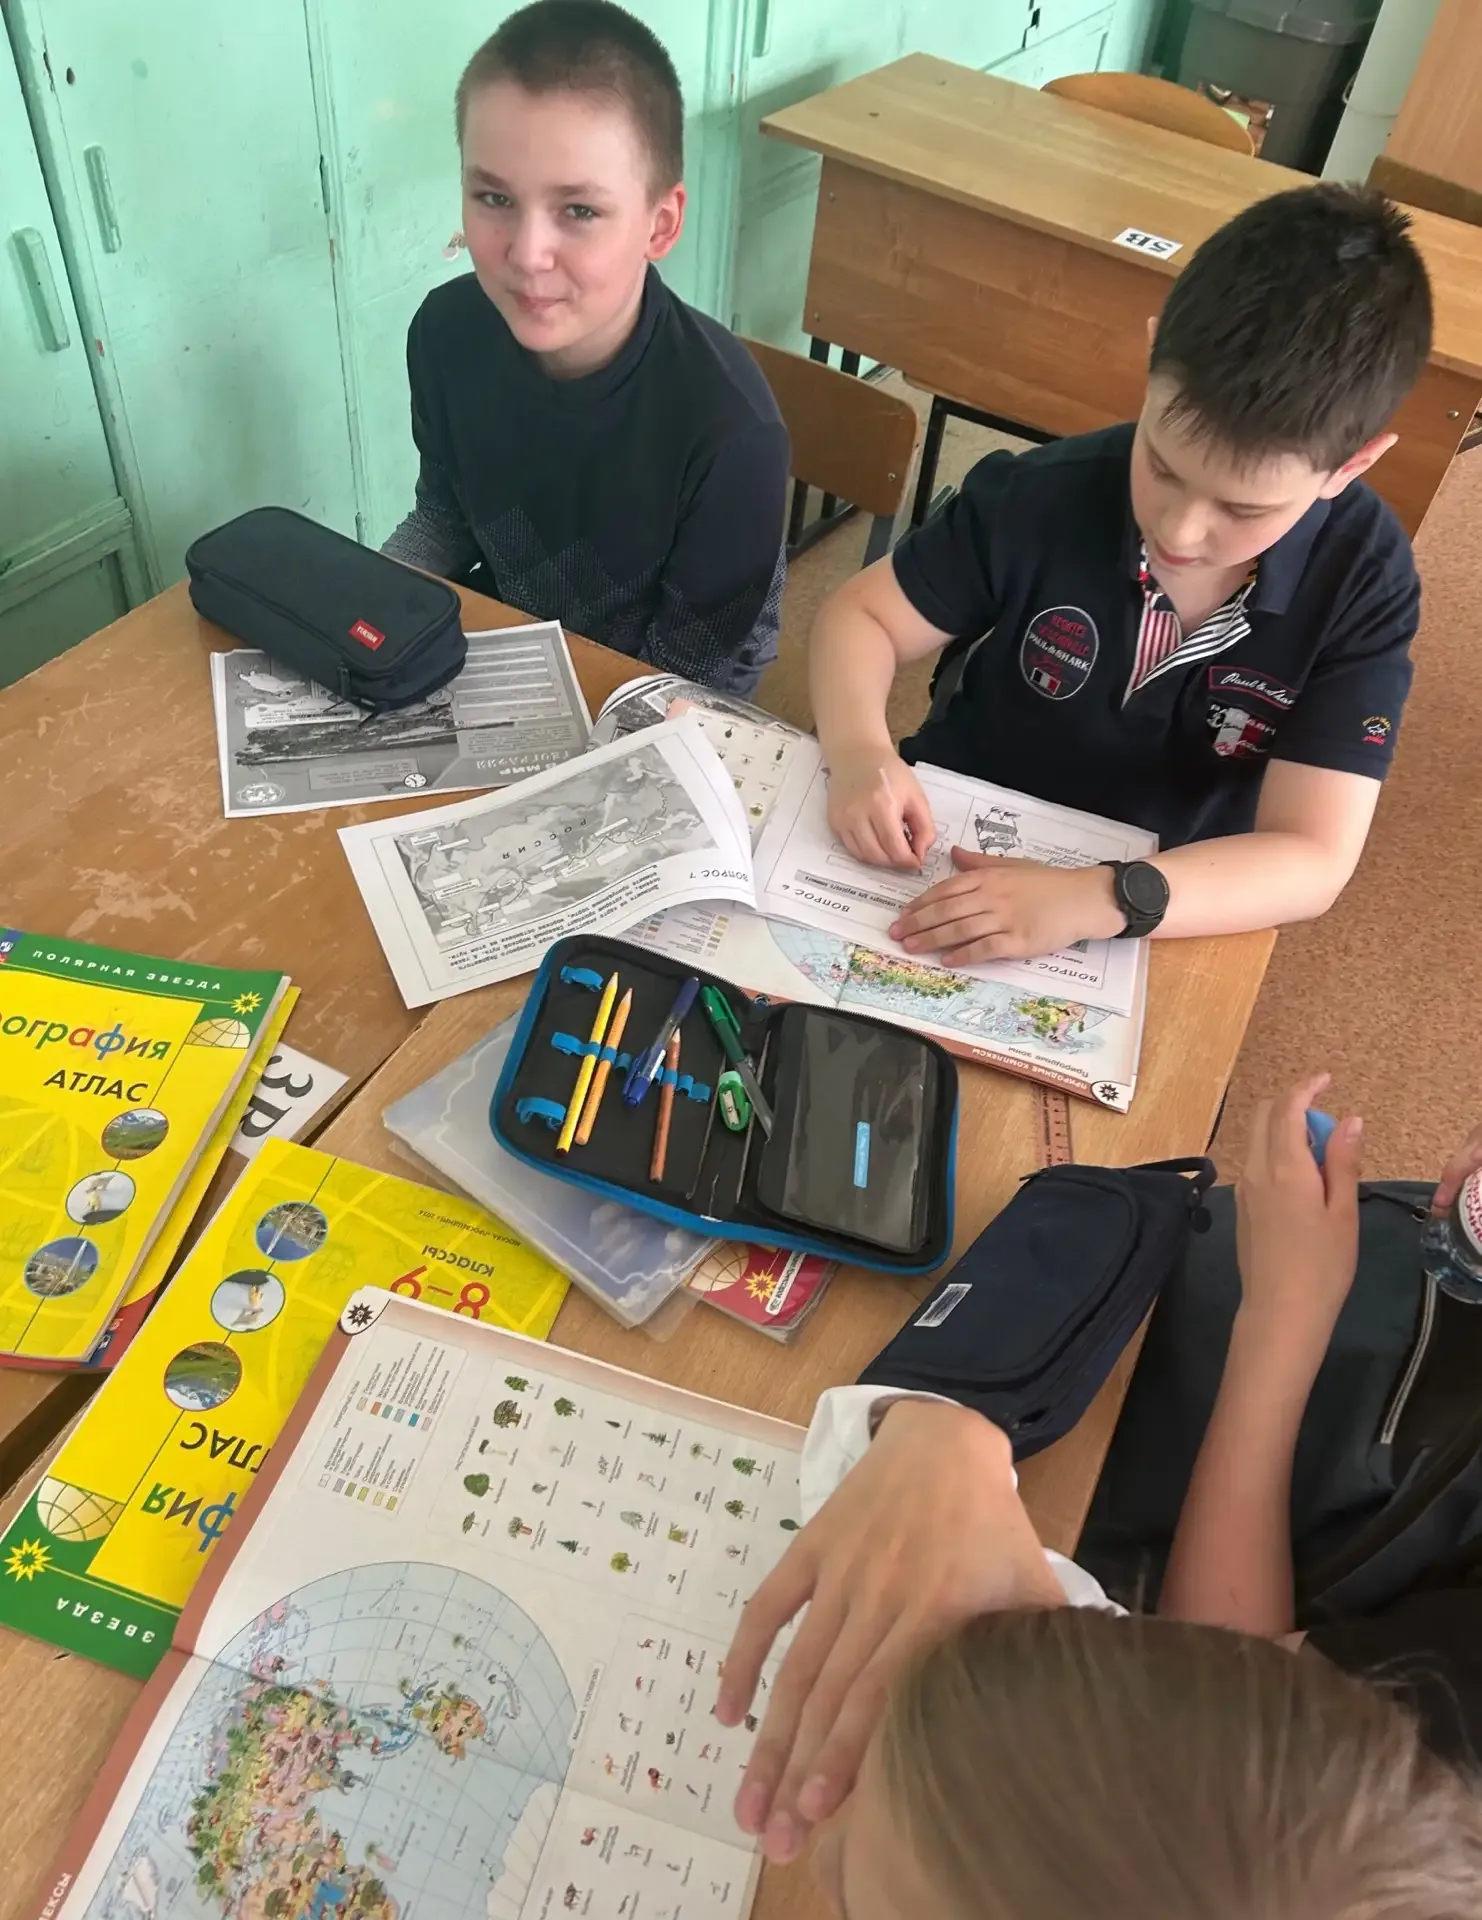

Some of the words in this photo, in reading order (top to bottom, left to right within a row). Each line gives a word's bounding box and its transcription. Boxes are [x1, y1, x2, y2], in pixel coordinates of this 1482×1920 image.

[502, 817, 587, 860] РОССИЯ
[795, 888, 851, 912] ВОПРОС
[32, 949, 136, 978] ПОЛЯРНАЯ
[146, 972, 222, 991] ЗВЕЗДА
[1041, 963, 1099, 983] ВОПРОС
[0, 1015, 172, 1062] ография
[972, 1047, 1030, 1072] КОМПЛЕКСЫ
[43, 1068, 148, 1102] АТЛАС
[1032, 1064, 1088, 1090] ПРИРОДНЫЕ
[421, 1245, 495, 1277] классы
[57, 1597, 155, 1643] ЗВЕЗДА
